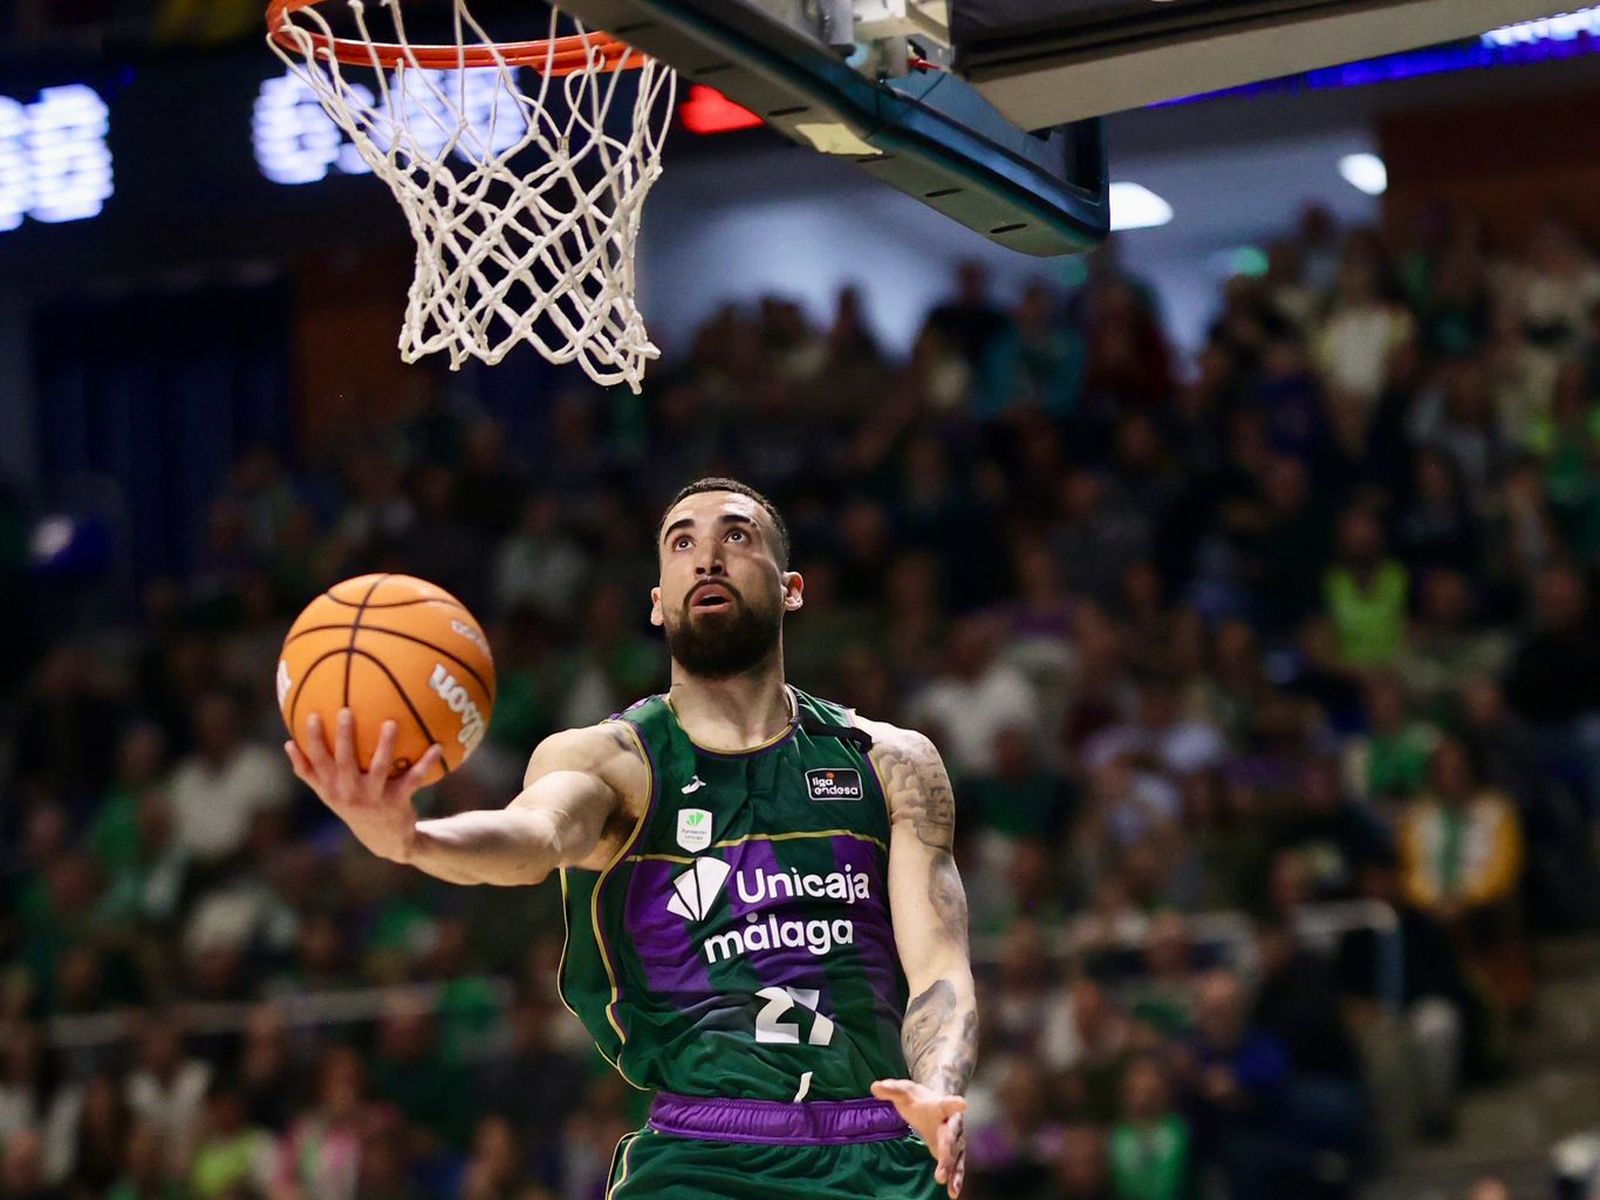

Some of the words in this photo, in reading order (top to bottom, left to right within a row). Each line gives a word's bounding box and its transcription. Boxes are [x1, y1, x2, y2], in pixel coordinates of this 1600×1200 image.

[812, 776, 834, 787] liga
[814, 785, 859, 795] endesa
[736, 863, 870, 904] Unicaja
[755, 985, 835, 1046] 27
